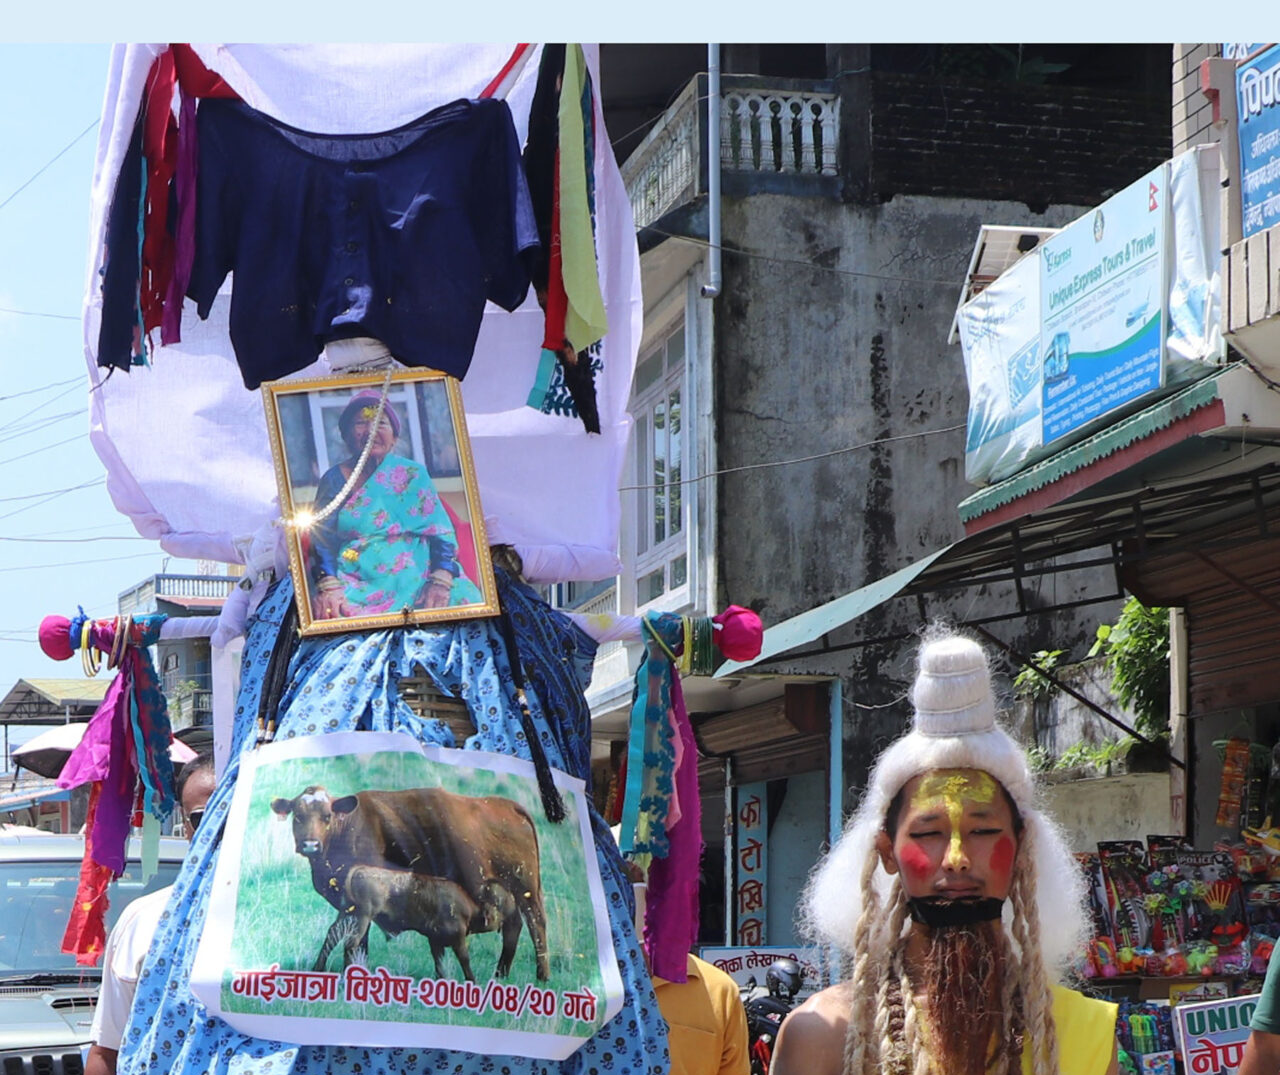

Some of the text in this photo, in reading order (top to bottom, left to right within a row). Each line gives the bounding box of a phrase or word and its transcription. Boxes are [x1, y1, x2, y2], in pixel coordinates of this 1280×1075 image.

[1049, 227, 1156, 310] Unique Express Tours & Travel
[233, 965, 338, 1002] गाईजात्रा
[564, 987, 596, 1021] गते
